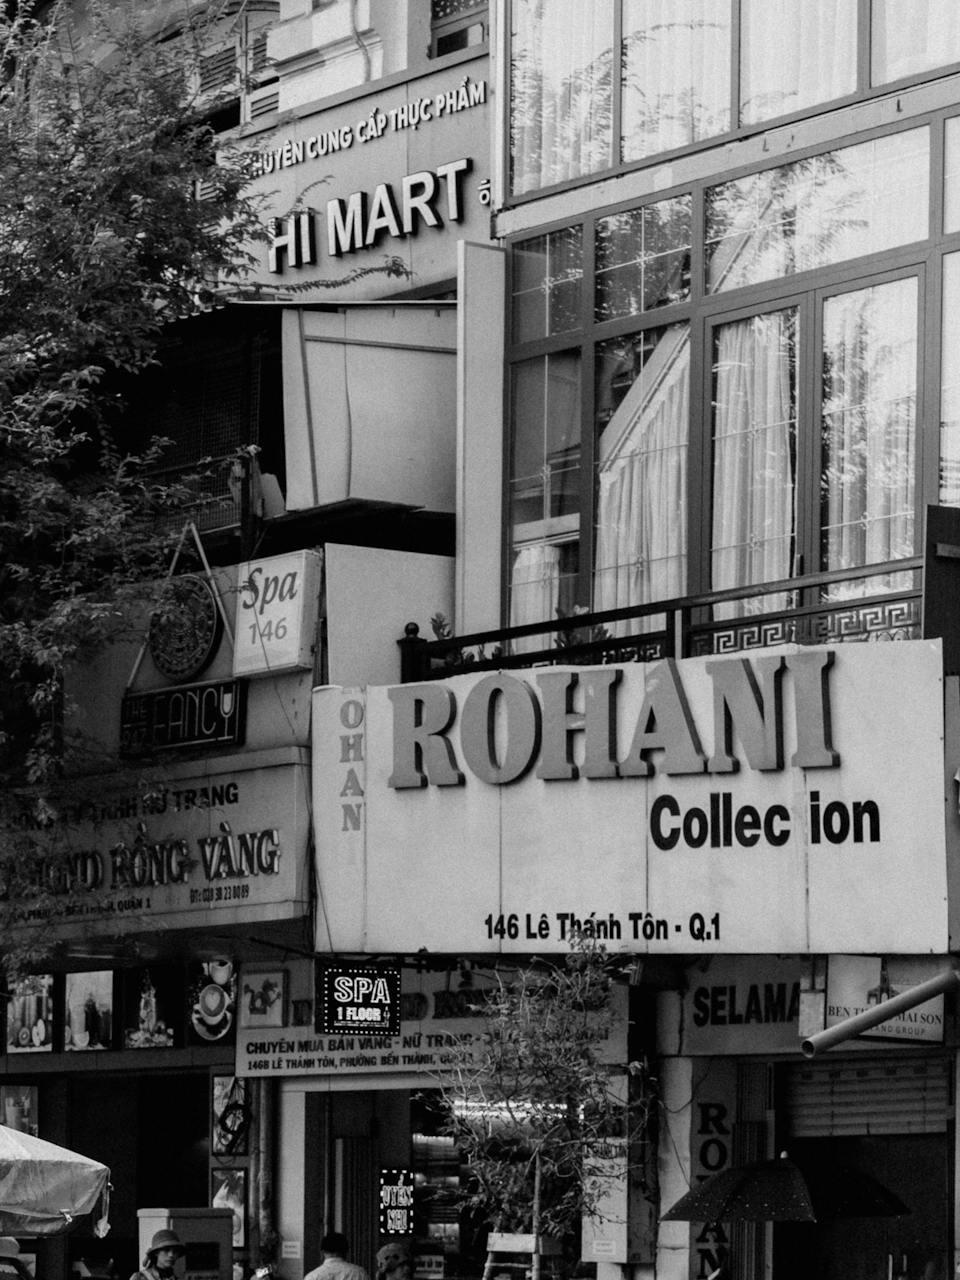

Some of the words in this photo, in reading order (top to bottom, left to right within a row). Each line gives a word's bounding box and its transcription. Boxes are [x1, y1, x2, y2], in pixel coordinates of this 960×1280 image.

[249, 139, 304, 177] HUYÊN
[306, 126, 355, 161] CUNG
[355, 107, 389, 146] CẤP
[390, 98, 434, 132] THỰC
[434, 76, 487, 117] PHẨM
[326, 157, 472, 257] MART
[242, 567, 298, 615] Spa
[249, 617, 288, 645] 146
[387, 650, 842, 790] ROHANI
[172, 782, 239, 811] TRANG
[197, 821, 281, 881] VÀNG
[484, 913, 519, 940] 146
[526, 913, 550, 940] Lê
[556, 911, 622, 940] Thánh
[628, 912, 669, 940] Tôn
[690, 912, 721, 941] Q.1
[333, 976, 391, 1004] SPA
[337, 1006, 343, 1020] 1
[345, 1006, 382, 1022] FLOOR
[828, 1005, 851, 1017] BEN
[246, 1038, 295, 1054] CHUYÊN
[297, 1039, 325, 1053] MUA
[402, 1032, 422, 1049] NỮ
[896, 1025, 925, 1036] GROUP
[272, 1057, 283, 1069] LÊ
[286, 1056, 315, 1069] THÁNH
[340, 1053, 377, 1067] PHƯỜNG
[380, 1052, 399, 1066] BẾN
